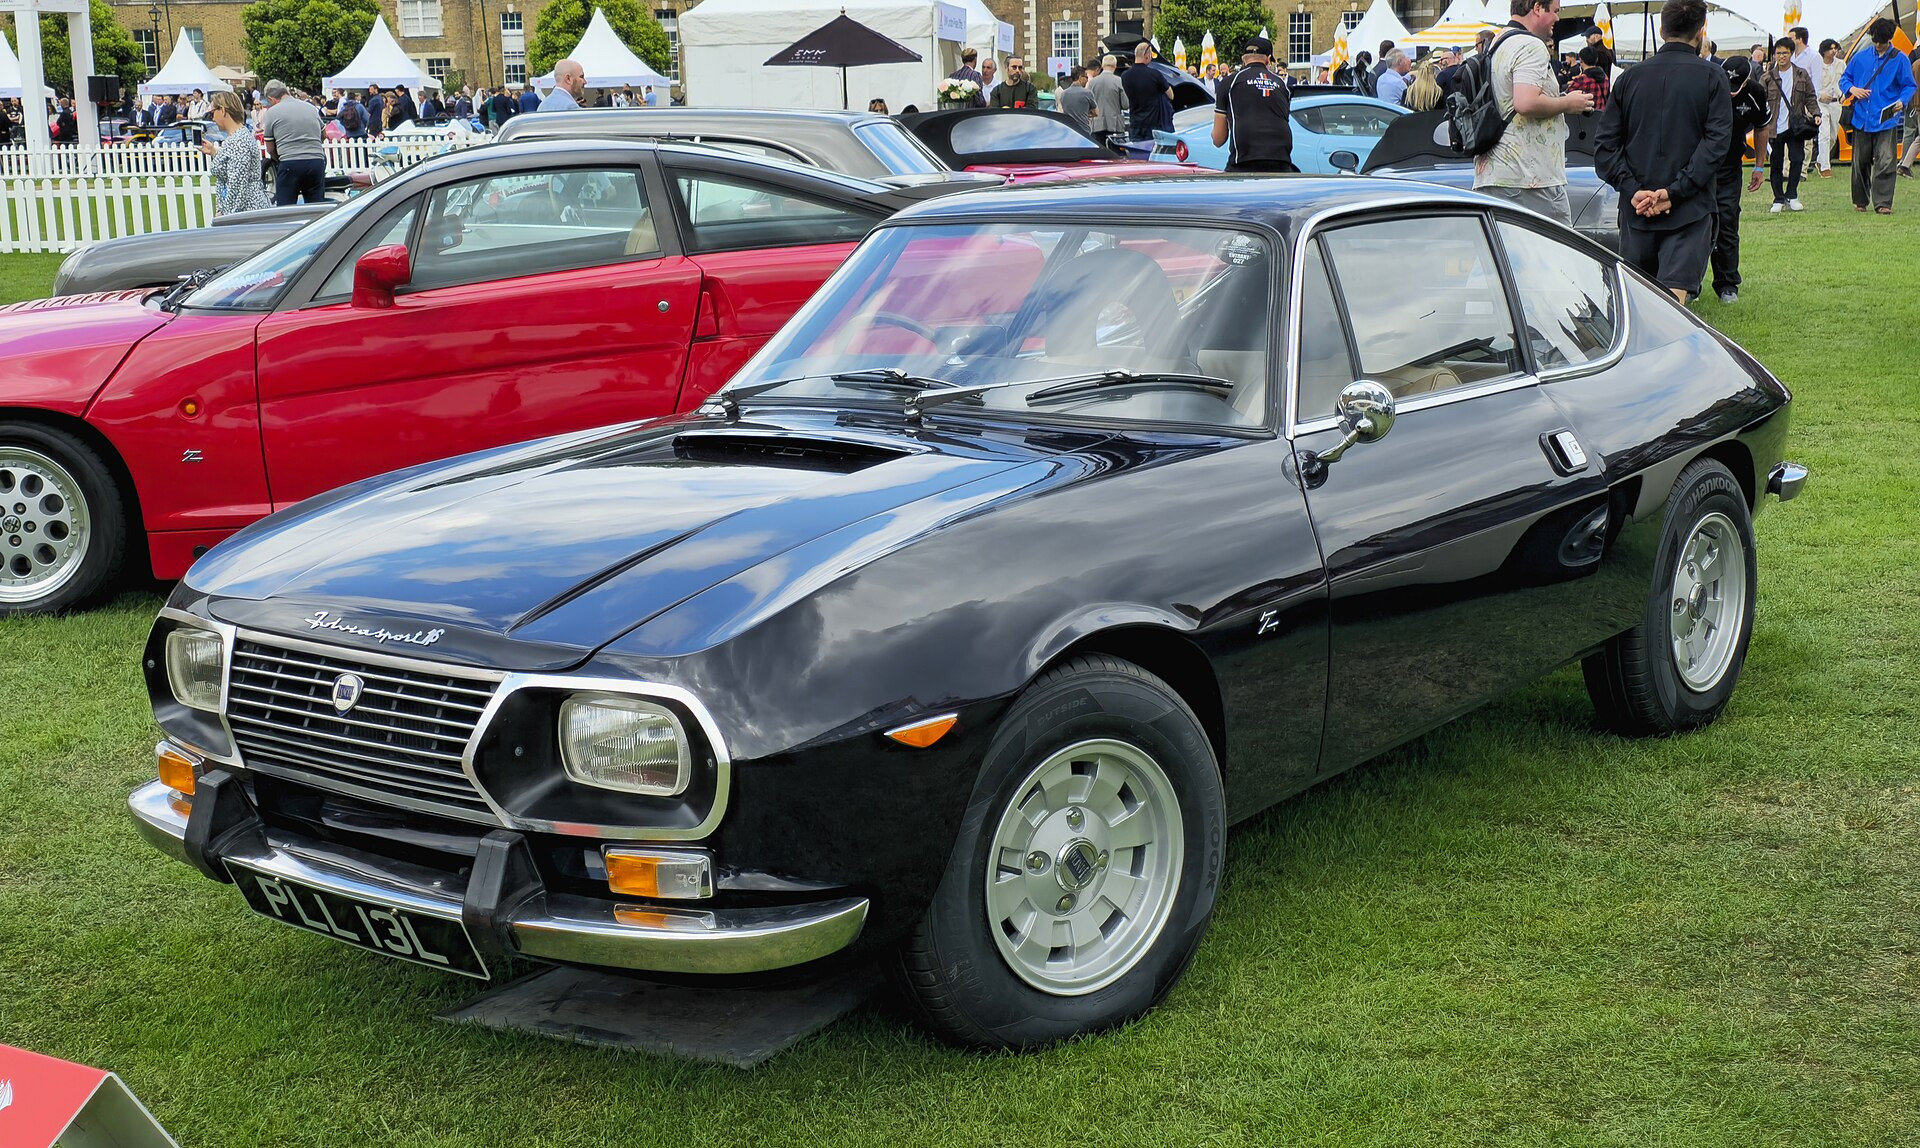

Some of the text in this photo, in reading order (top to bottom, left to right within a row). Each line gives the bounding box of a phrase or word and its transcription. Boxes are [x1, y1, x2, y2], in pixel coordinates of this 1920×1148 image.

[1229, 252, 1250, 260] ENTRANT
[255, 875, 450, 965] PLL 13L
